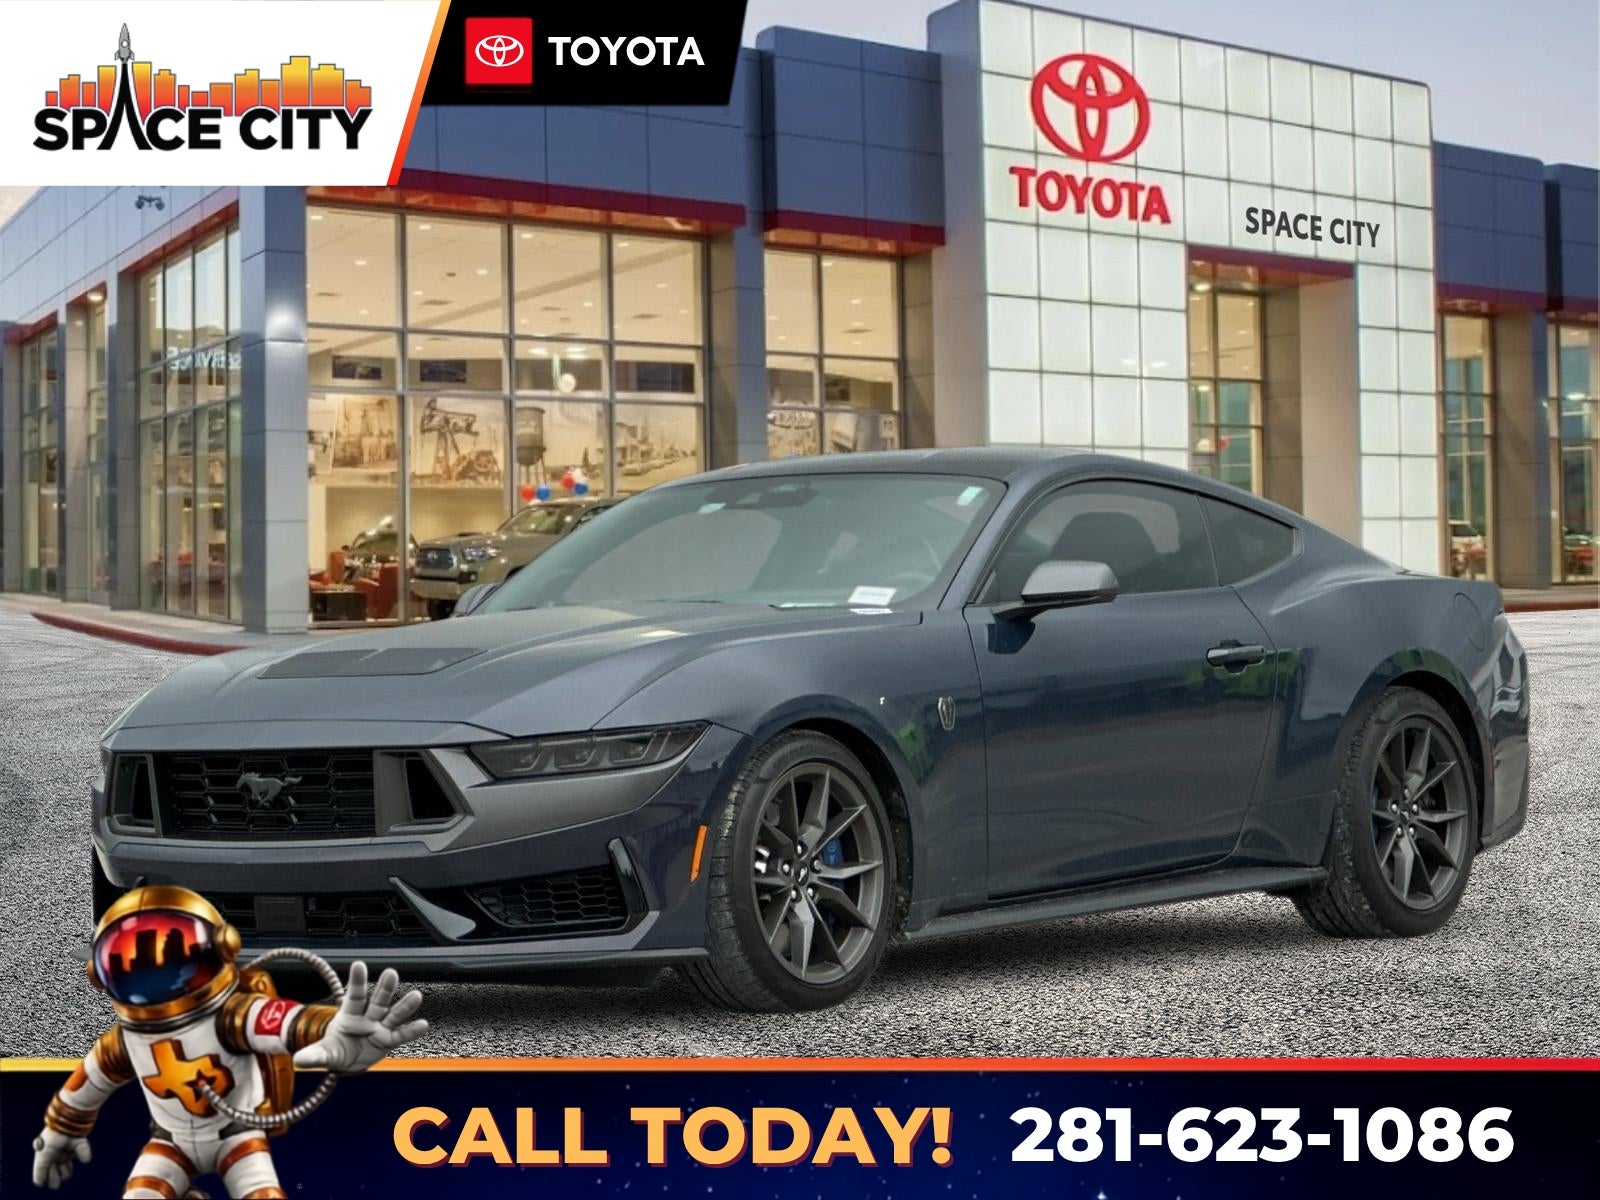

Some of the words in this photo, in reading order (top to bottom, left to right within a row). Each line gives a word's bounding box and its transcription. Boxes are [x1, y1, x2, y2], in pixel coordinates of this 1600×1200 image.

[1009, 166, 1172, 224] TOYOTA
[1245, 206, 1323, 242] SPACE
[1329, 217, 1381, 248] CITY
